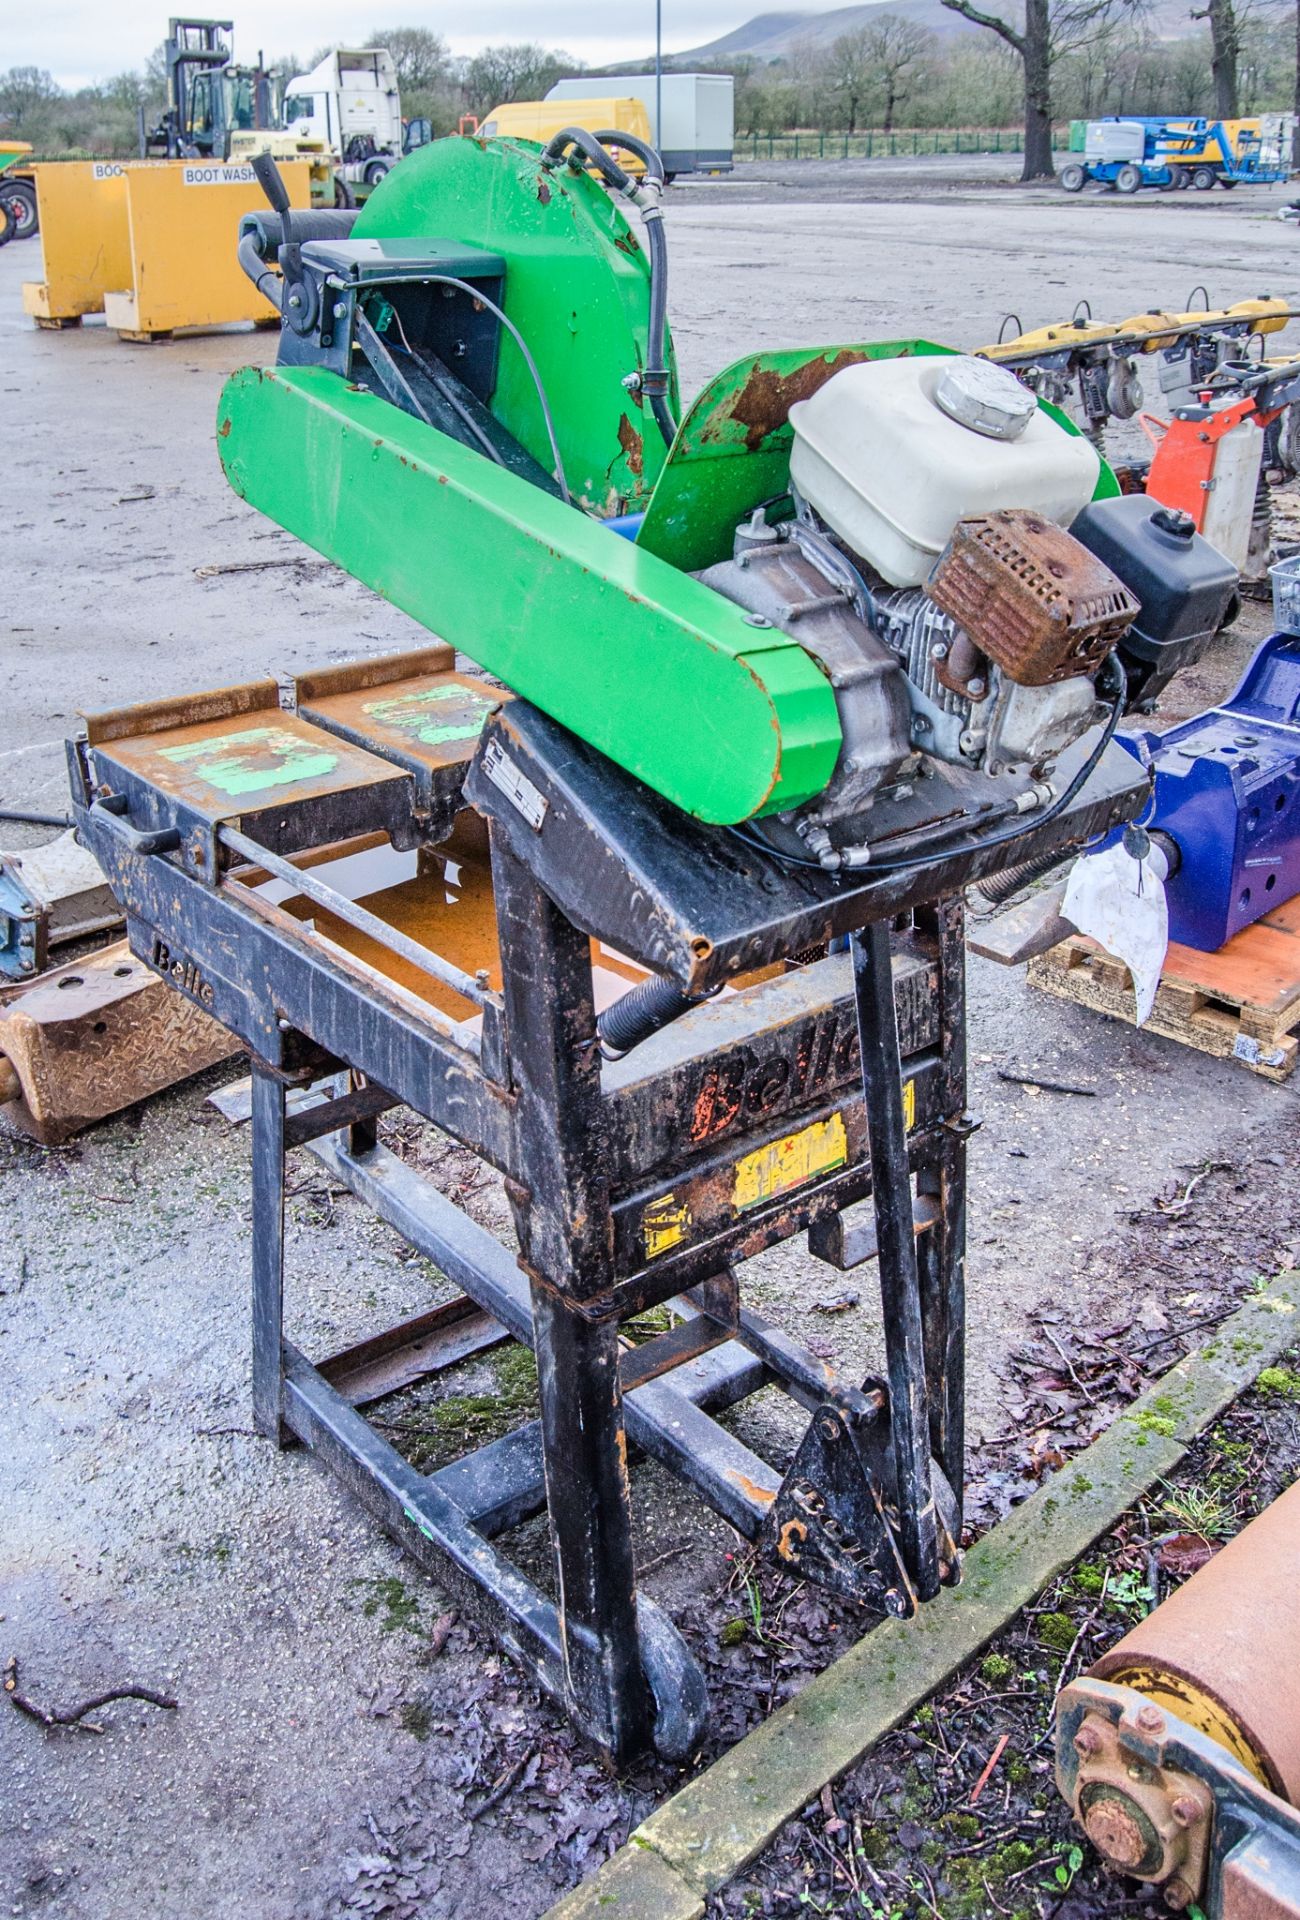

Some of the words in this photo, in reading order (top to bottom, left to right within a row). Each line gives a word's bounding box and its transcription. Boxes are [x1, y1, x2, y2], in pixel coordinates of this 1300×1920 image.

[95, 164, 123, 178] BOO
[186, 168, 219, 183] BOOT
[222, 167, 257, 182] WASH
[154, 939, 215, 1005] Belle
